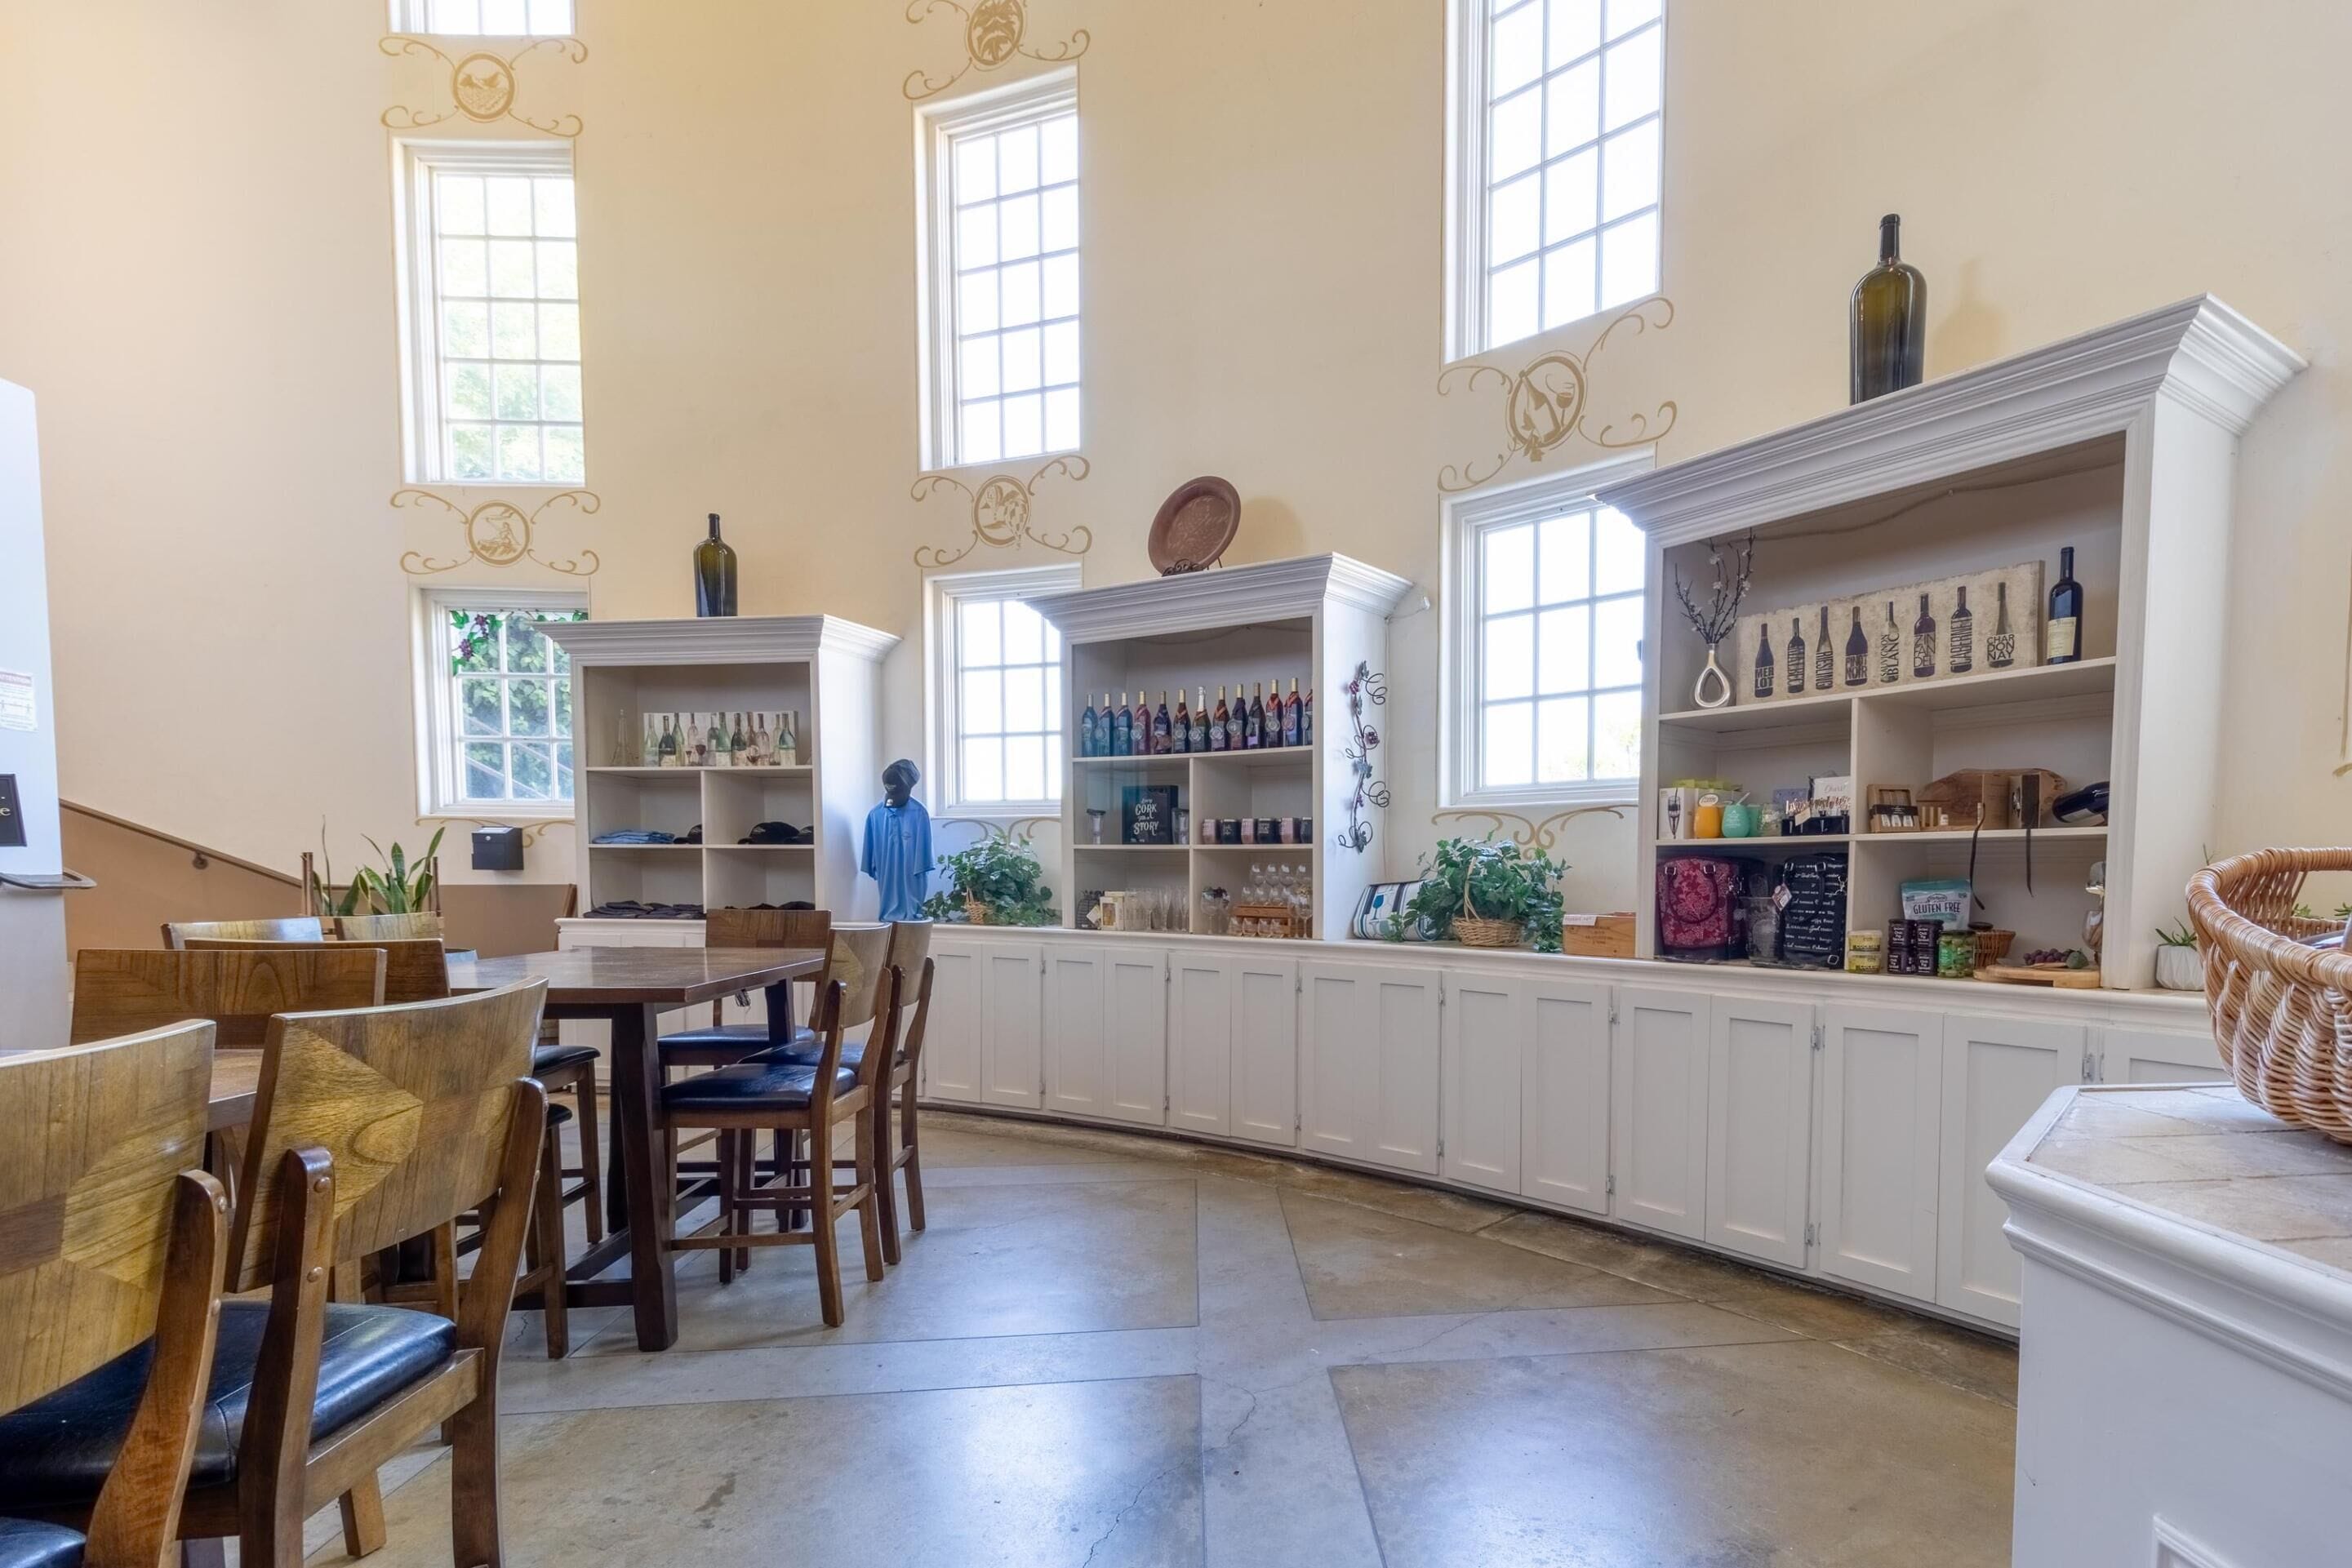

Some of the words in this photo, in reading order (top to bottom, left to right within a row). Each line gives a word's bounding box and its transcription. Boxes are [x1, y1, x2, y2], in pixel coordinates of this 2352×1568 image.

[1950, 618, 1972, 666] CABERNET
[1986, 633, 2015, 645] CHAR
[1880, 634, 1888, 677] SAUVIGNON
[1887, 633, 1900, 676] BLANC
[1914, 655, 1935, 668] DEL
[1987, 650, 2013, 662] NAY
[1754, 666, 1774, 679] MER
[1815, 651, 1834, 687] RIESLING
[1846, 665, 1867, 680] NOIR
[1754, 677, 1773, 690] LOT
[1136, 803, 1157, 819] CORK
[1134, 821, 1159, 836] STORY
[1913, 903, 1941, 914] GLUTEN
[1945, 902, 1961, 913] FREE
